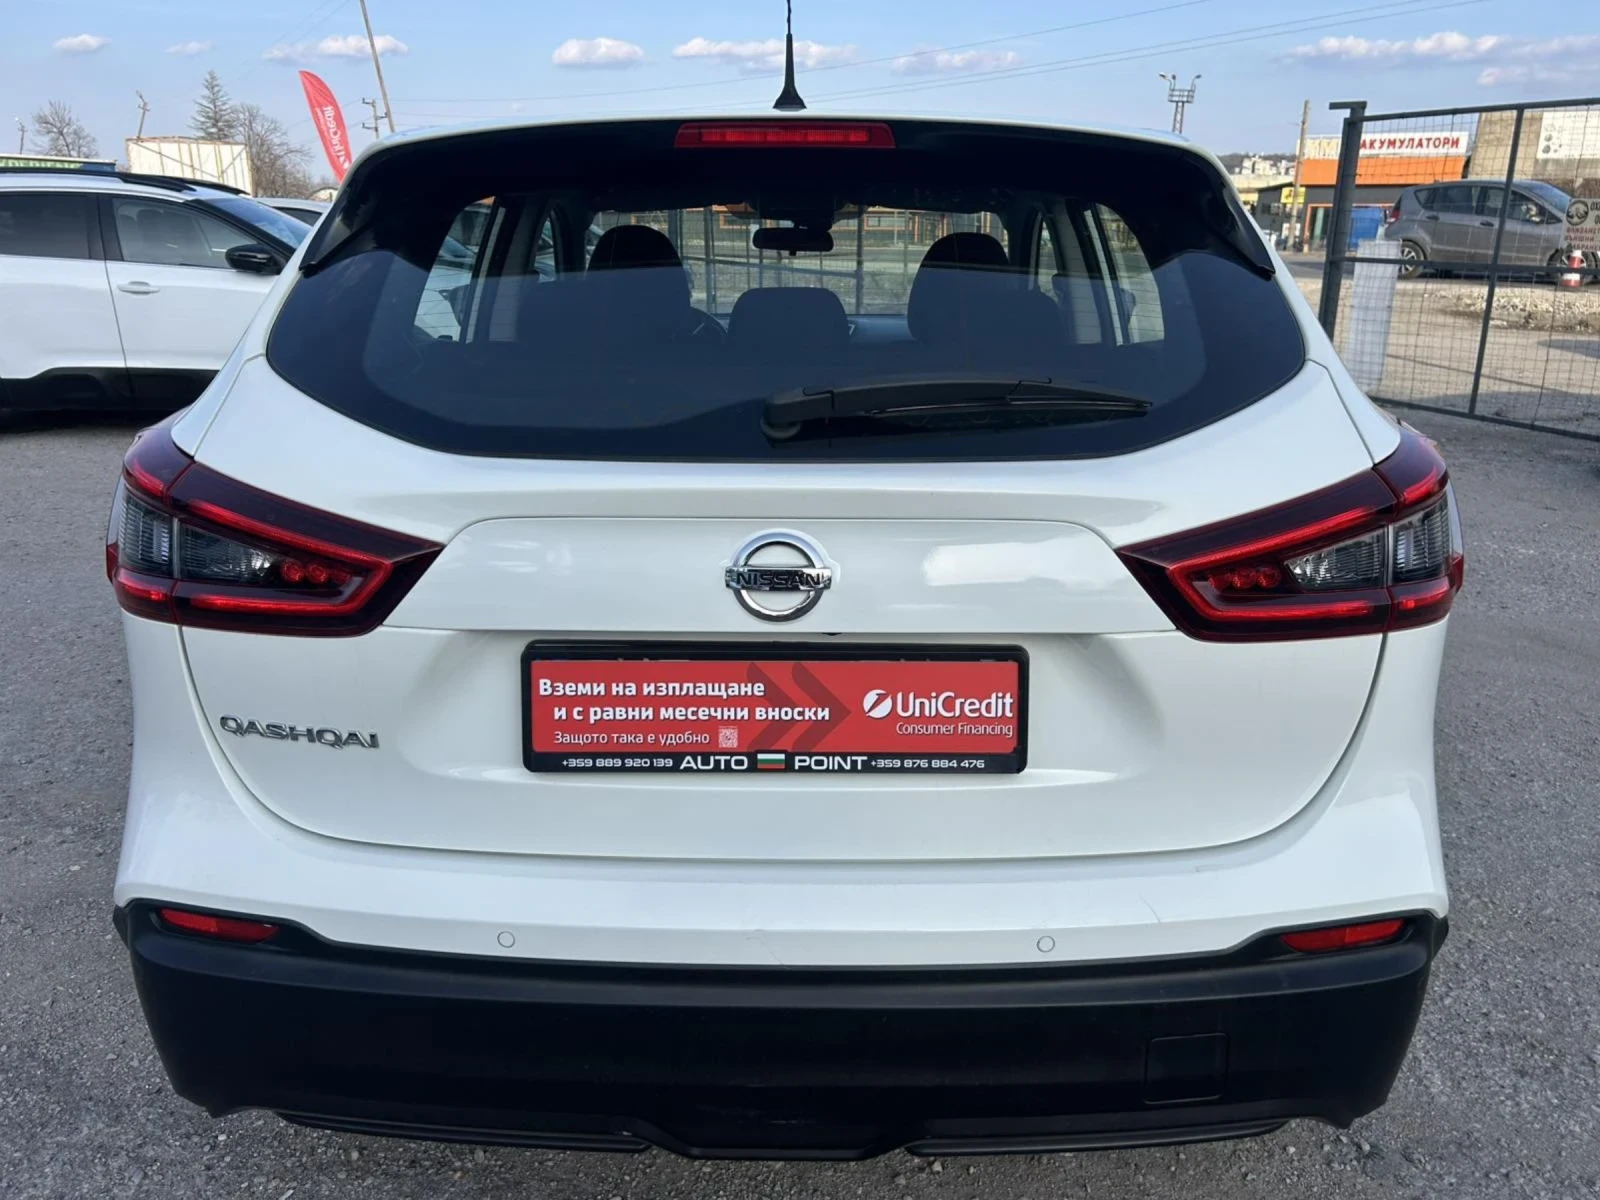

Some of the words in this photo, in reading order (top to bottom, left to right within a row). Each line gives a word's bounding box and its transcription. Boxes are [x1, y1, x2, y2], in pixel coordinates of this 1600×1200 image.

[1360, 137, 1460, 150] АКУМУЛАТОРИ
[736, 572, 820, 586] NISSAN
[538, 678, 606, 696] Вземи
[611, 682, 637, 696] на
[642, 682, 765, 699] изплащане
[896, 691, 1014, 718] UniCredit
[553, 706, 567, 720] и
[572, 706, 584, 720] с
[589, 706, 654, 724] равни
[659, 706, 749, 721] месечни
[755, 706, 830, 721] вноски
[219, 714, 380, 750] QASHQAI
[896, 722, 955, 735] Consumer
[958, 722, 1013, 738] Financing
[553, 731, 608, 745] Защото
[611, 733, 644, 744] така
[647, 734, 655, 744] е
[659, 731, 710, 746] удобно
[562, 758, 593, 767] +359
[595, 758, 622, 767] 889
[624, 758, 650, 767] 920
[653, 758, 673, 767] 139
[679, 755, 749, 770] AUTO
[794, 755, 868, 770] POINT
[871, 759, 901, 768] +359
[903, 759, 928, 768] 876
[931, 759, 957, 768] 884
[960, 759, 985, 768] 476
